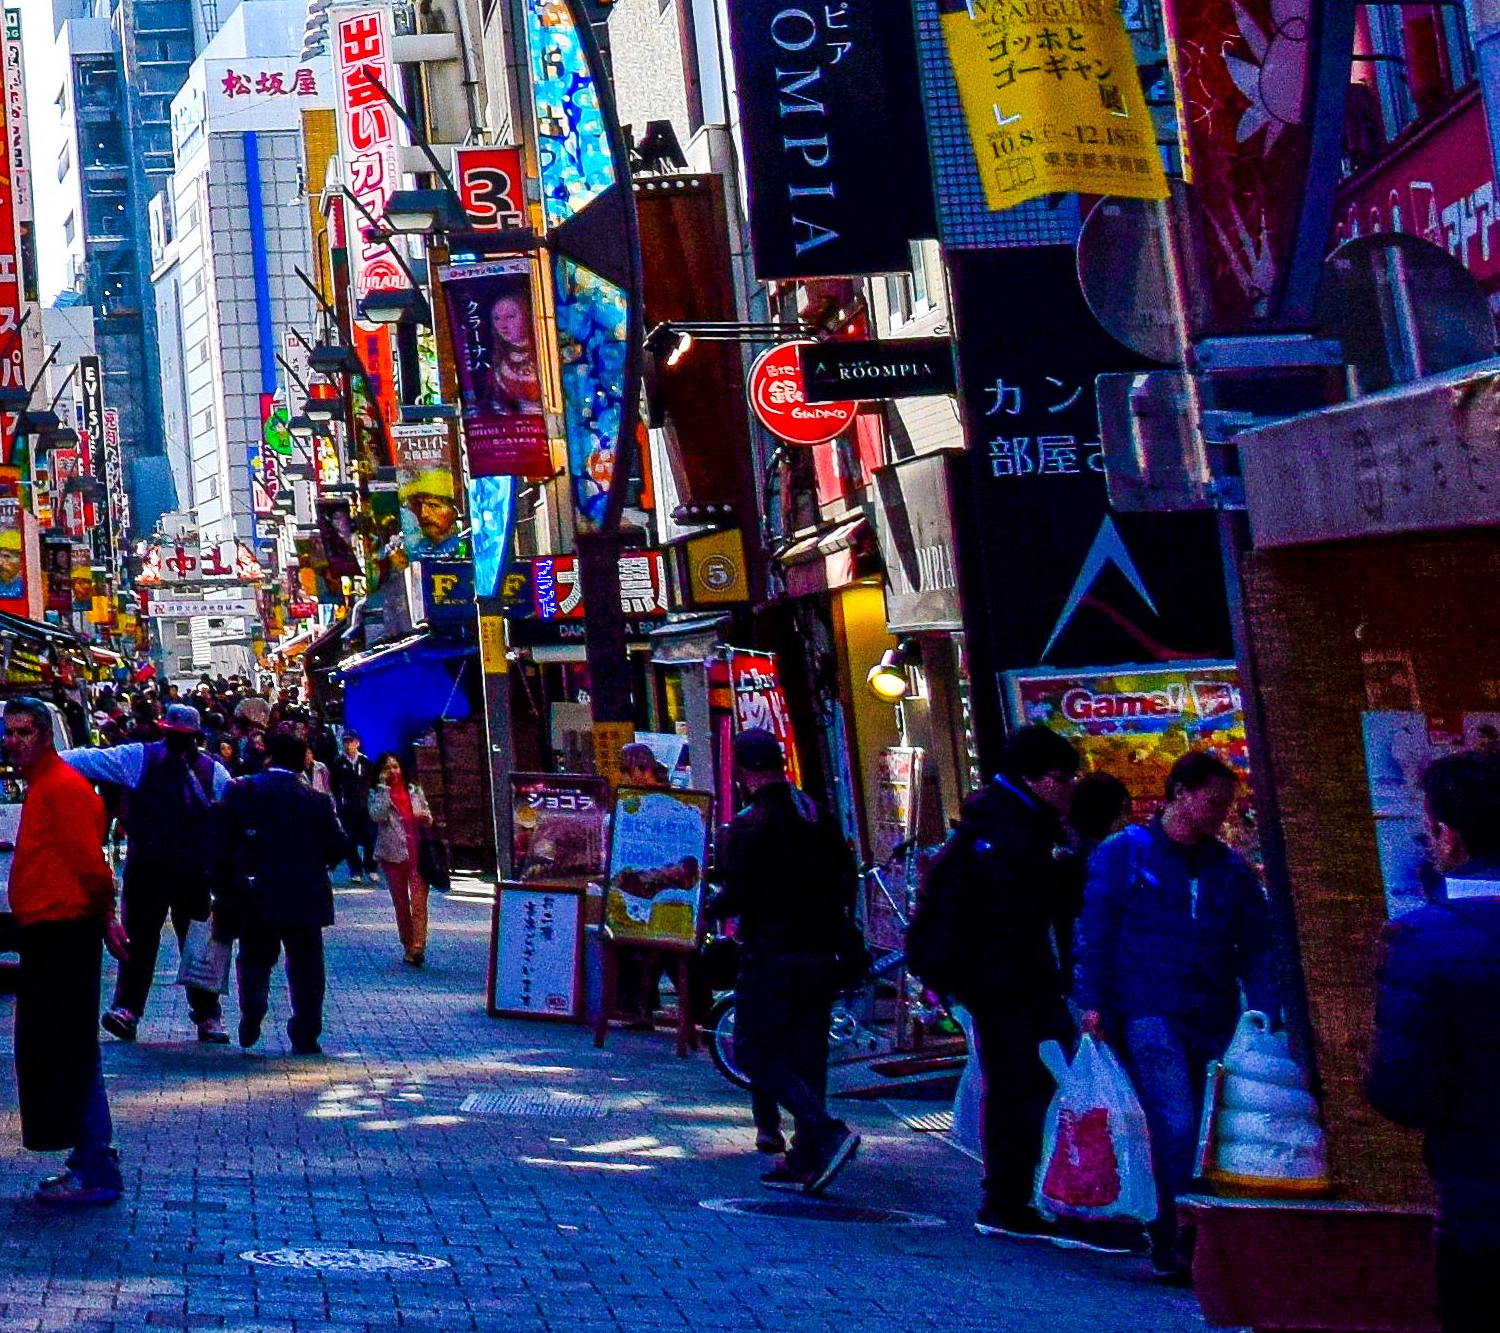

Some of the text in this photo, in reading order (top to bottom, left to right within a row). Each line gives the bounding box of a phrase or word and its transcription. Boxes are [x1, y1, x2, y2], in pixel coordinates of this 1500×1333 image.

[986, 26, 1086, 63] ゴッホと
[220, 67, 320, 100] 松坂屋
[992, 55, 1113, 90] ゴーギャン
[839, 363, 933, 381] ROOMPIA
[526, 792, 595, 811] ショコラ
